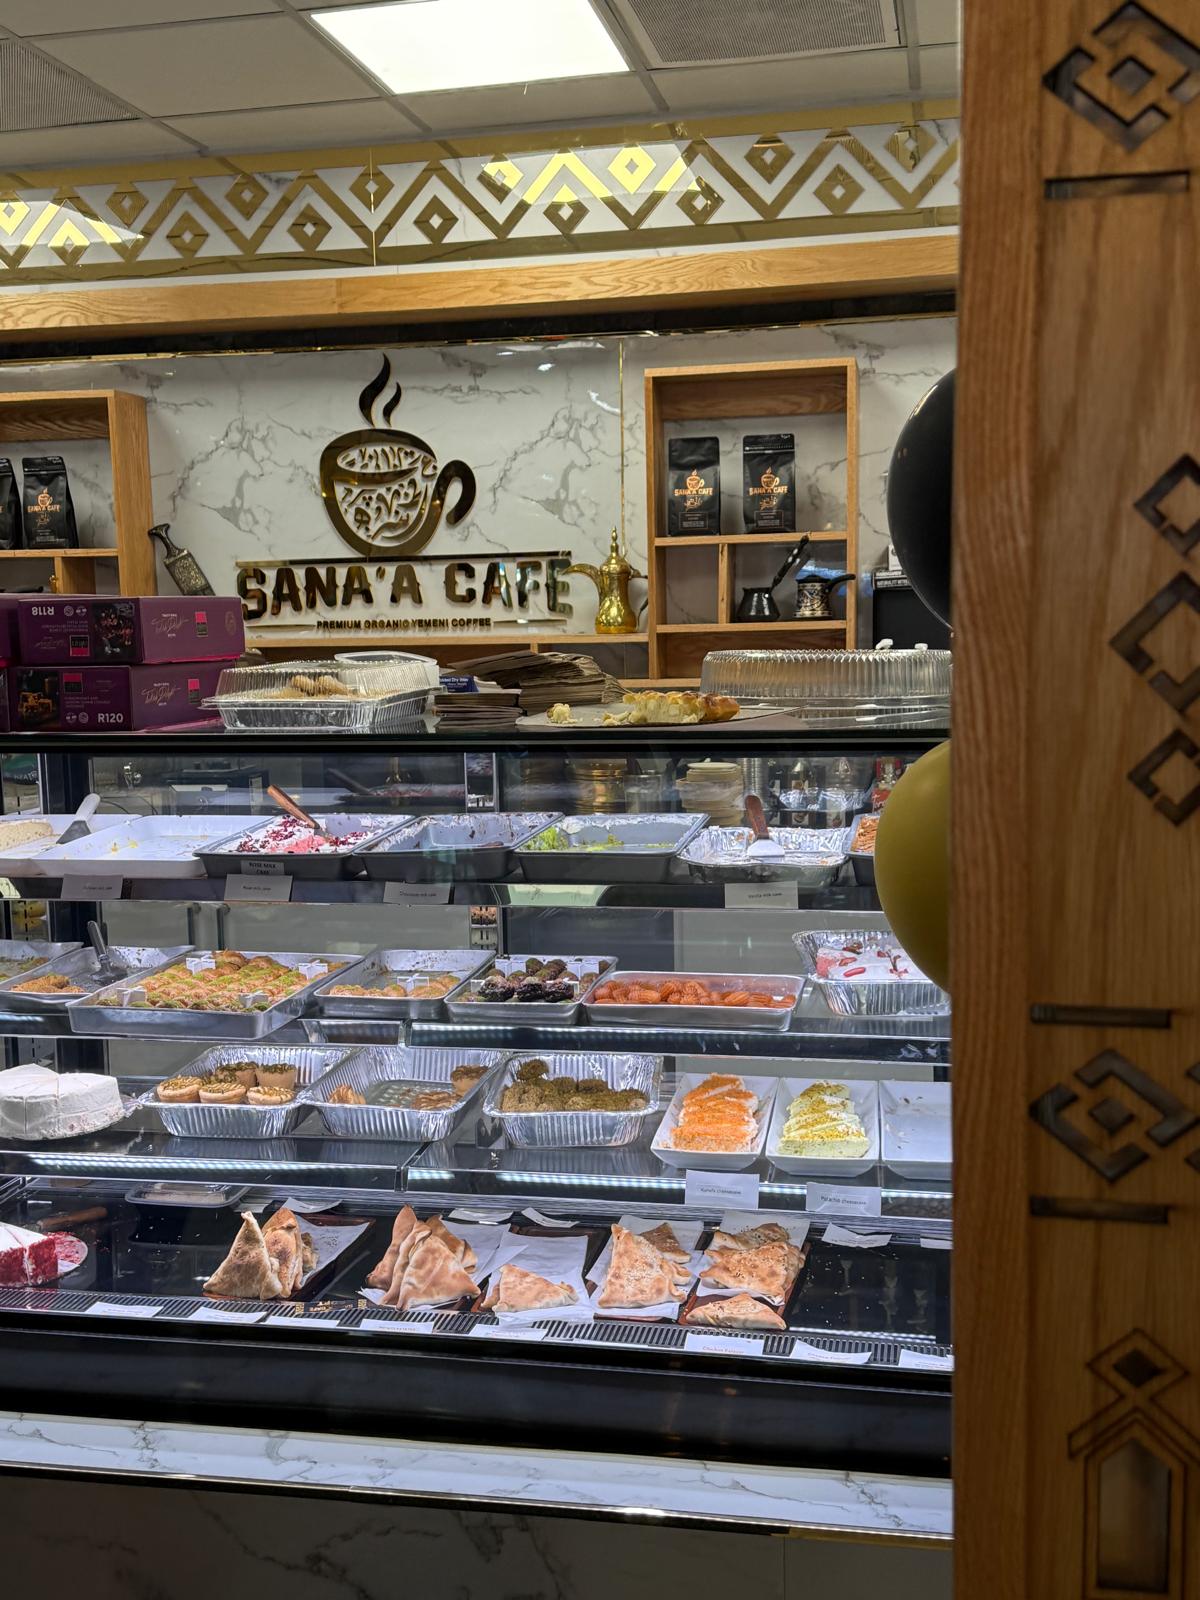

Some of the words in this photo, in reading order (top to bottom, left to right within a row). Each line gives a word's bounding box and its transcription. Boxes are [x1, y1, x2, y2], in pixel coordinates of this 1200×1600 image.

[698, 487, 714, 496] CAFE
[774, 486, 788, 494] CAFE
[237, 563, 423, 620] SANA'A
[444, 559, 574, 617] CAFE
[31, 605, 55, 617] R118
[316, 620, 361, 630] PREMIUM
[364, 619, 410, 630] ORGANIC
[411, 618, 449, 629] YEMENI
[451, 618, 492, 627] COFFEE
[97, 712, 124, 724] R120
